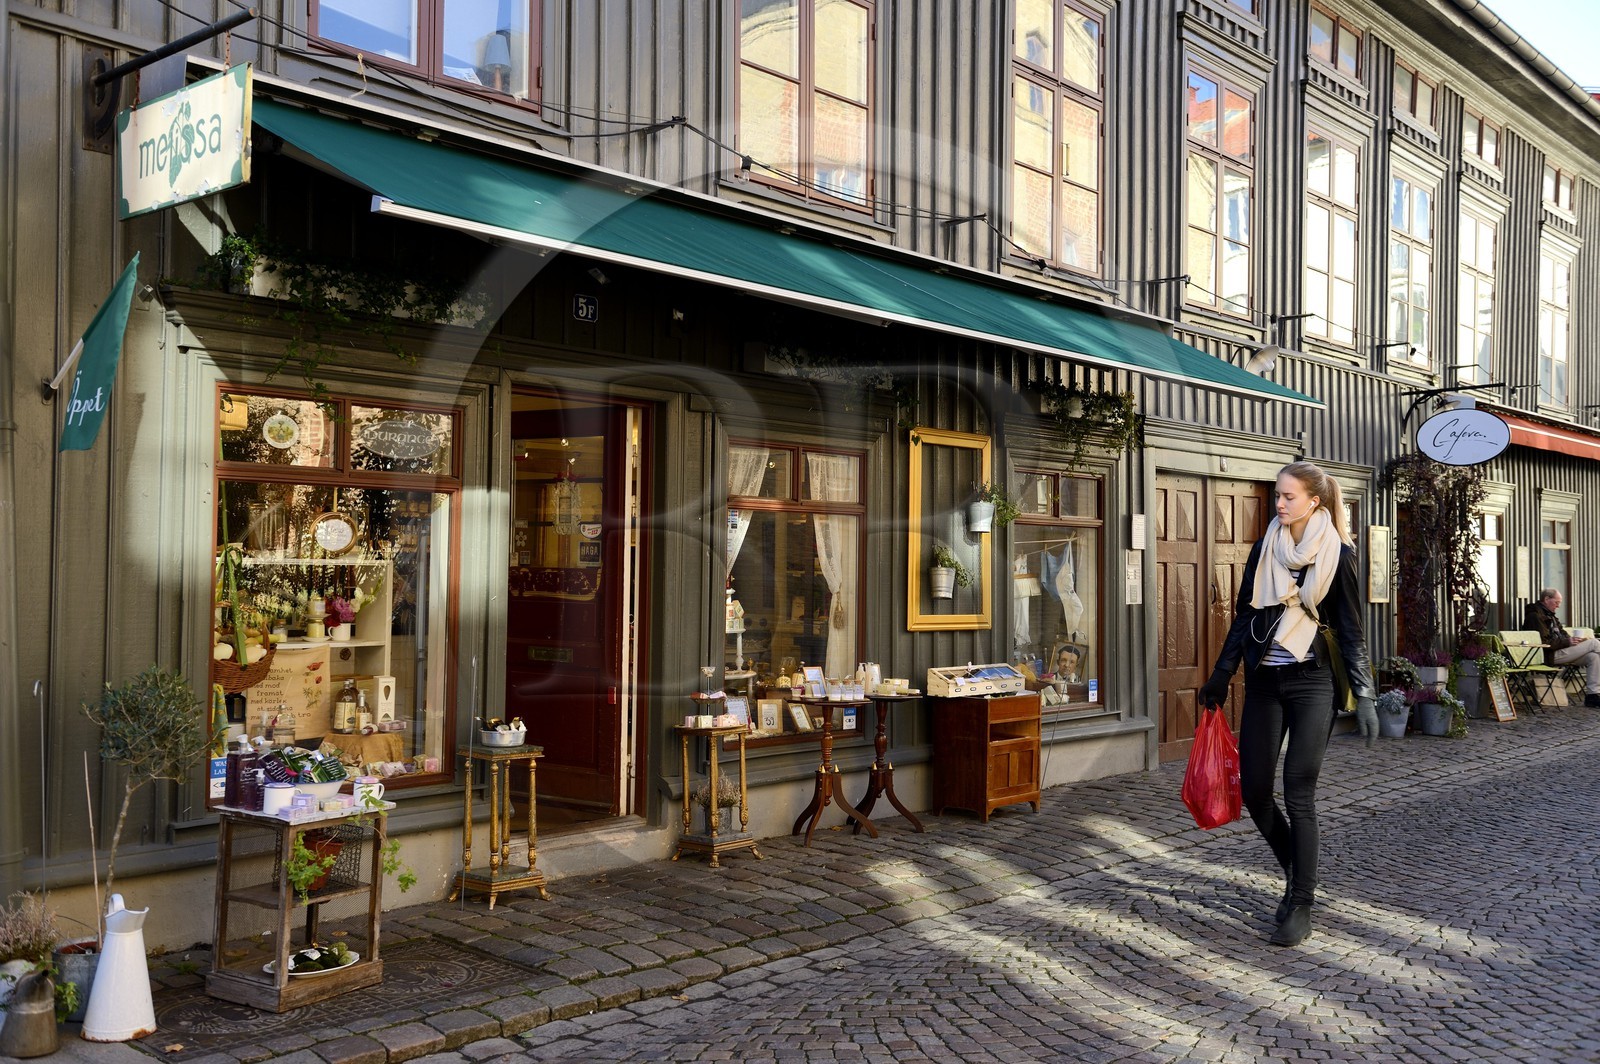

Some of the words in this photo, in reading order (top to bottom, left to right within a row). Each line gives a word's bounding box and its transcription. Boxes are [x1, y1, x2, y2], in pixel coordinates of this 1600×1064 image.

[139, 113, 222, 179] melissa
[66, 369, 106, 427] Öppet
[580, 546, 598, 556] HAGA
